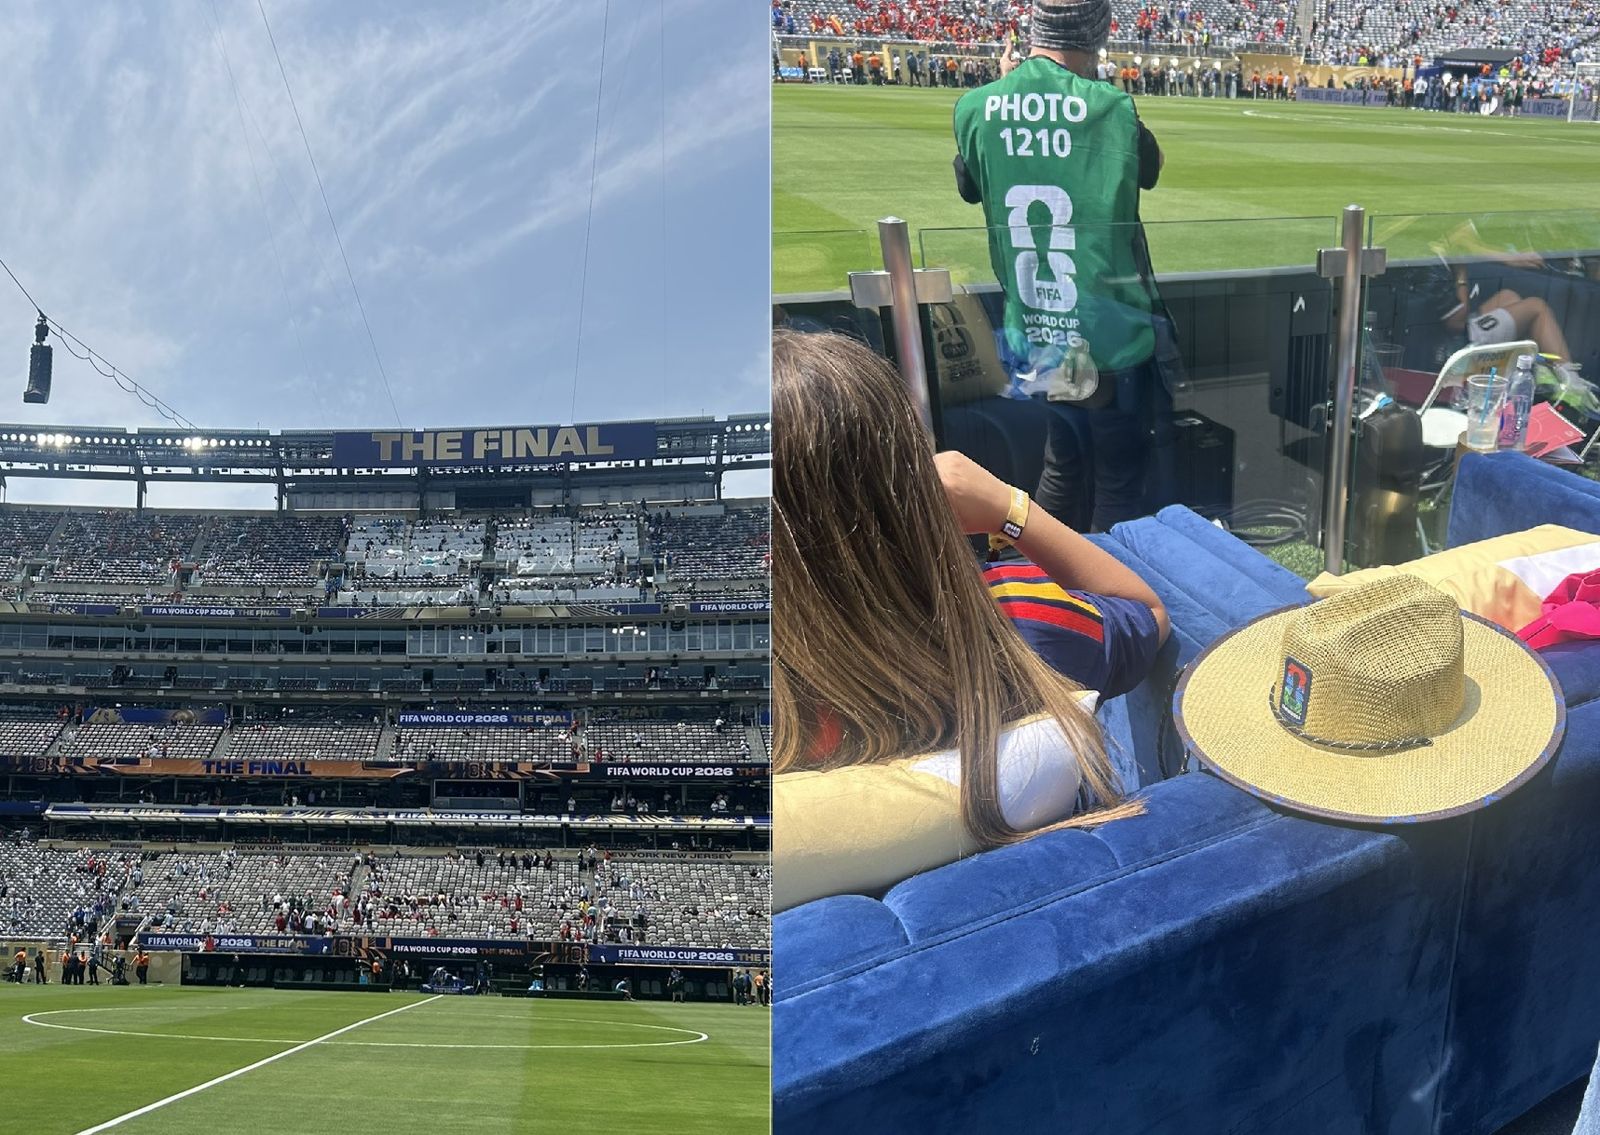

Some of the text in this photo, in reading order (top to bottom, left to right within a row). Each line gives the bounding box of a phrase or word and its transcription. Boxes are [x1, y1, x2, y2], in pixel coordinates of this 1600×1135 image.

[985, 93, 1088, 122] PHOTO
[1000, 127, 1072, 158] 1210
[1036, 287, 1062, 301] FIFA
[1023, 313, 1081, 329] WORLD CUP
[1025, 327, 1083, 347] 2026
[372, 426, 614, 461] THE FINAL
[420, 715, 454, 723] WORLD
[455, 715, 474, 723] CUP
[475, 715, 508, 723] 2026
[512, 715, 534, 723] THE
[202, 760, 312, 775] THE FINAL
[607, 767, 630, 776] FIFA
[631, 767, 670, 776] WORLD
[671, 767, 693, 776] CUP
[695, 767, 733, 776] 2026
[147, 937, 167, 945] FIFA
[168, 937, 199, 946] WORLD
[220, 939, 252, 947] 2026
[255, 939, 276, 947] THE
[410, 945, 435, 953] WORLD
[618, 949, 640, 958] FIFA
[640, 950, 676, 959] WORLD
[677, 951, 698, 960] CUP
[698, 952, 734, 961] 2026
[737, 953, 761, 962] THE
